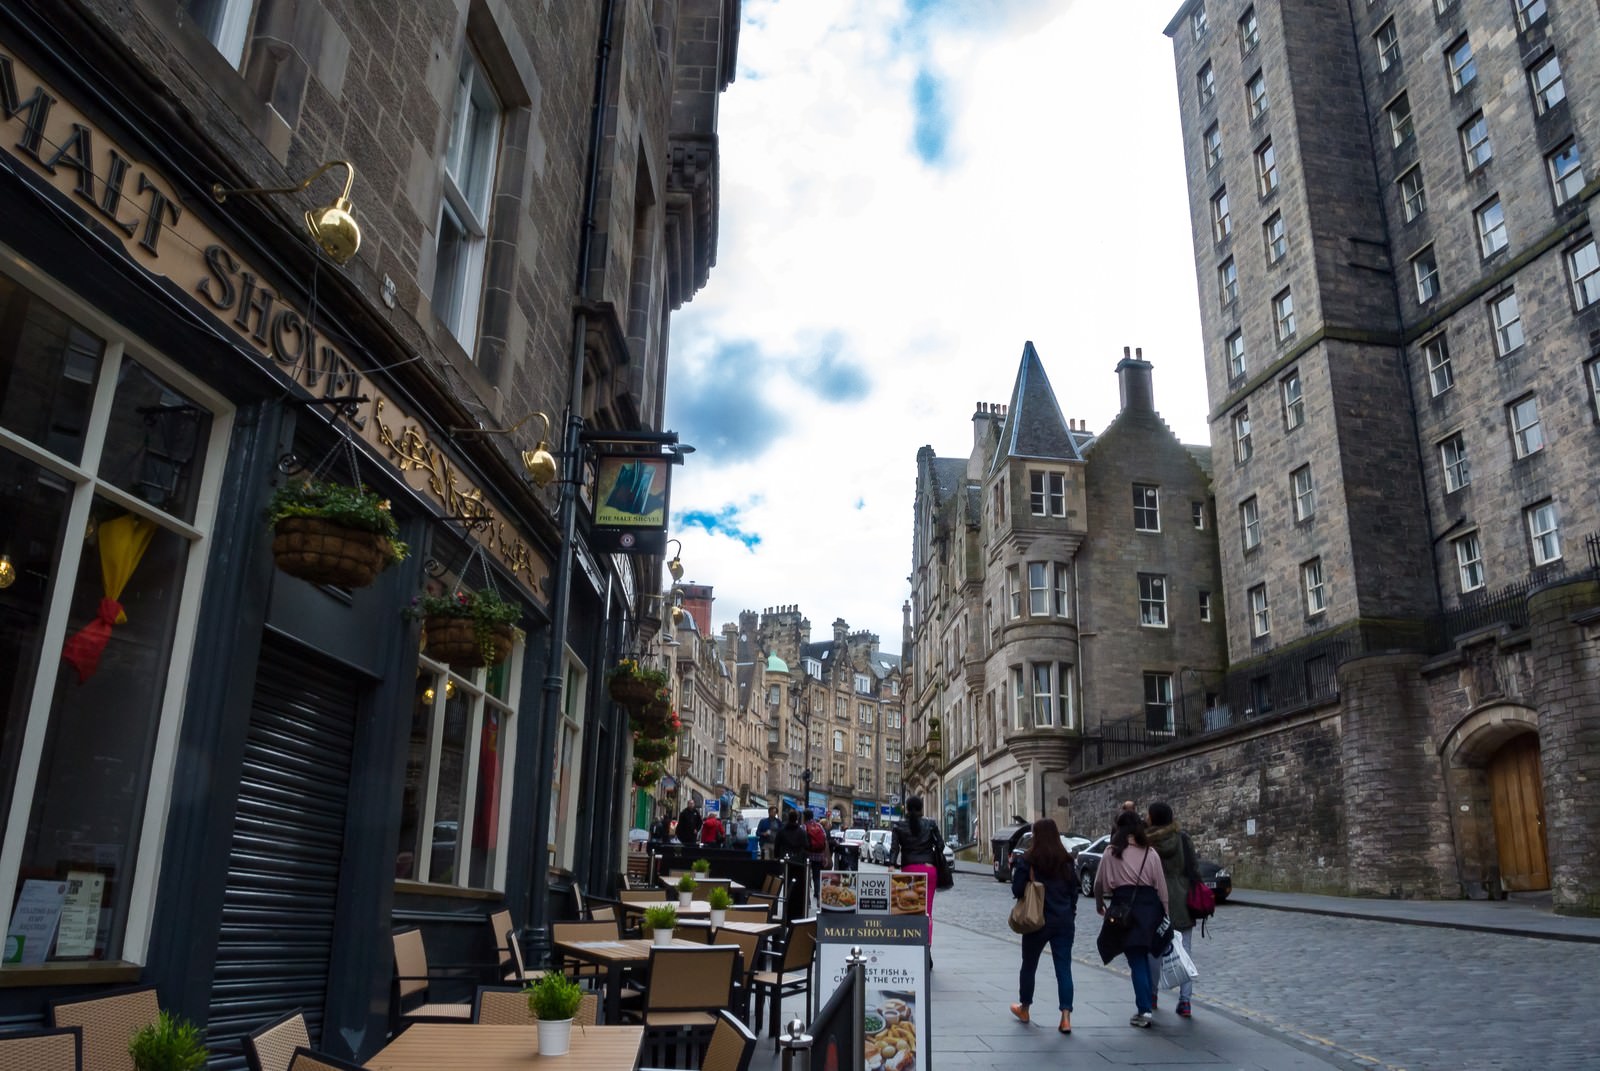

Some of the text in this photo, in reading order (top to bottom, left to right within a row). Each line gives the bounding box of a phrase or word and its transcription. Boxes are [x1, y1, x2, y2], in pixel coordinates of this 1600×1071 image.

[0, 53, 367, 431] MALT SHOVEL
[861, 880, 886, 888] NOW
[860, 888, 887, 896] HERE
[864, 920, 882, 928] THE
[824, 927, 922, 938] MALT SHOVEL INN
[881, 968, 899, 976] FISH
